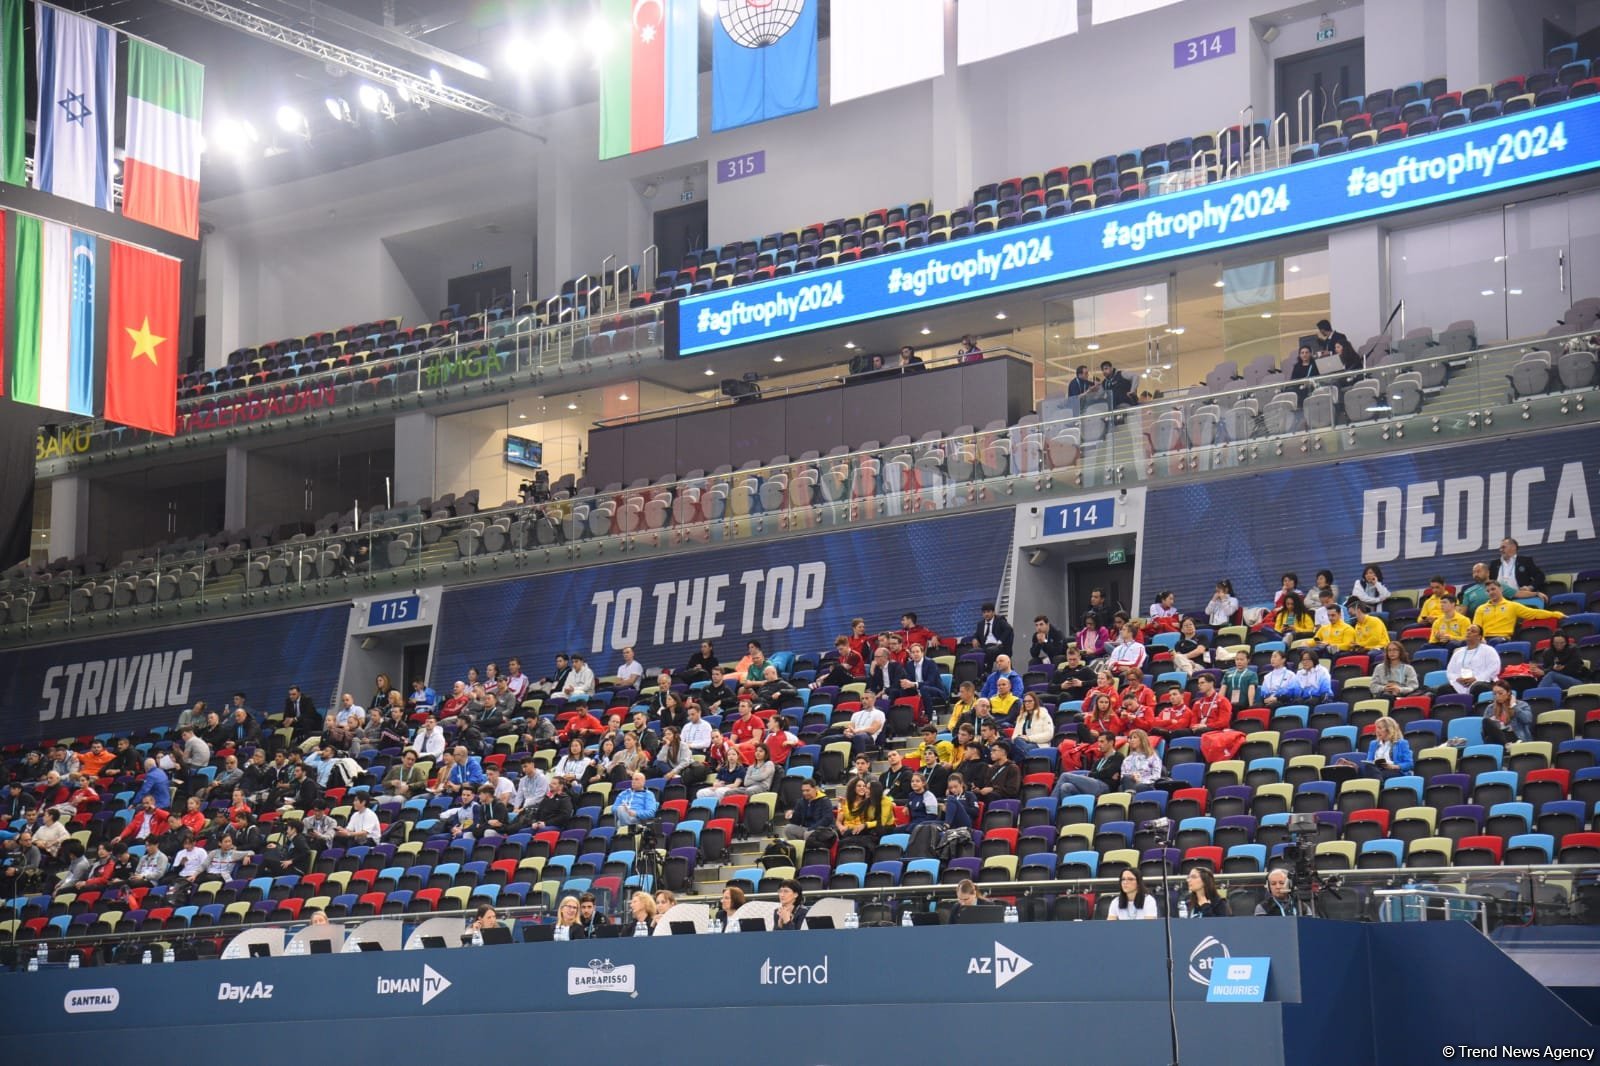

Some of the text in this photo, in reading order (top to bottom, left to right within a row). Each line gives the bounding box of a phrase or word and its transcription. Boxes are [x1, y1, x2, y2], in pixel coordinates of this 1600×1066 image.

[1187, 35, 1222, 61] 314
[728, 156, 755, 178] 315
[1347, 121, 1567, 198] #agftrophy2024
[1101, 183, 1290, 250] #agftrophy2024
[888, 235, 1053, 300] #agftrophy2024
[697, 279, 844, 336] #agftrophy2024
[1060, 505, 1098, 529] 114
[1361, 461, 1600, 564] DEDICA
[381, 600, 409, 621] 115
[591, 561, 826, 653] TO THE TOP
[39, 648, 193, 722] STRIVING
[760, 955, 828, 985] trend
[967, 957, 1018, 974] AZ TV
[218, 981, 274, 1004] Day.Az
[425, 977, 442, 991] TV
[575, 974, 628, 986] BARBARISSO
[1213, 984, 1260, 996] INQUIRIES
[71, 995, 113, 1007] SANTRAL
